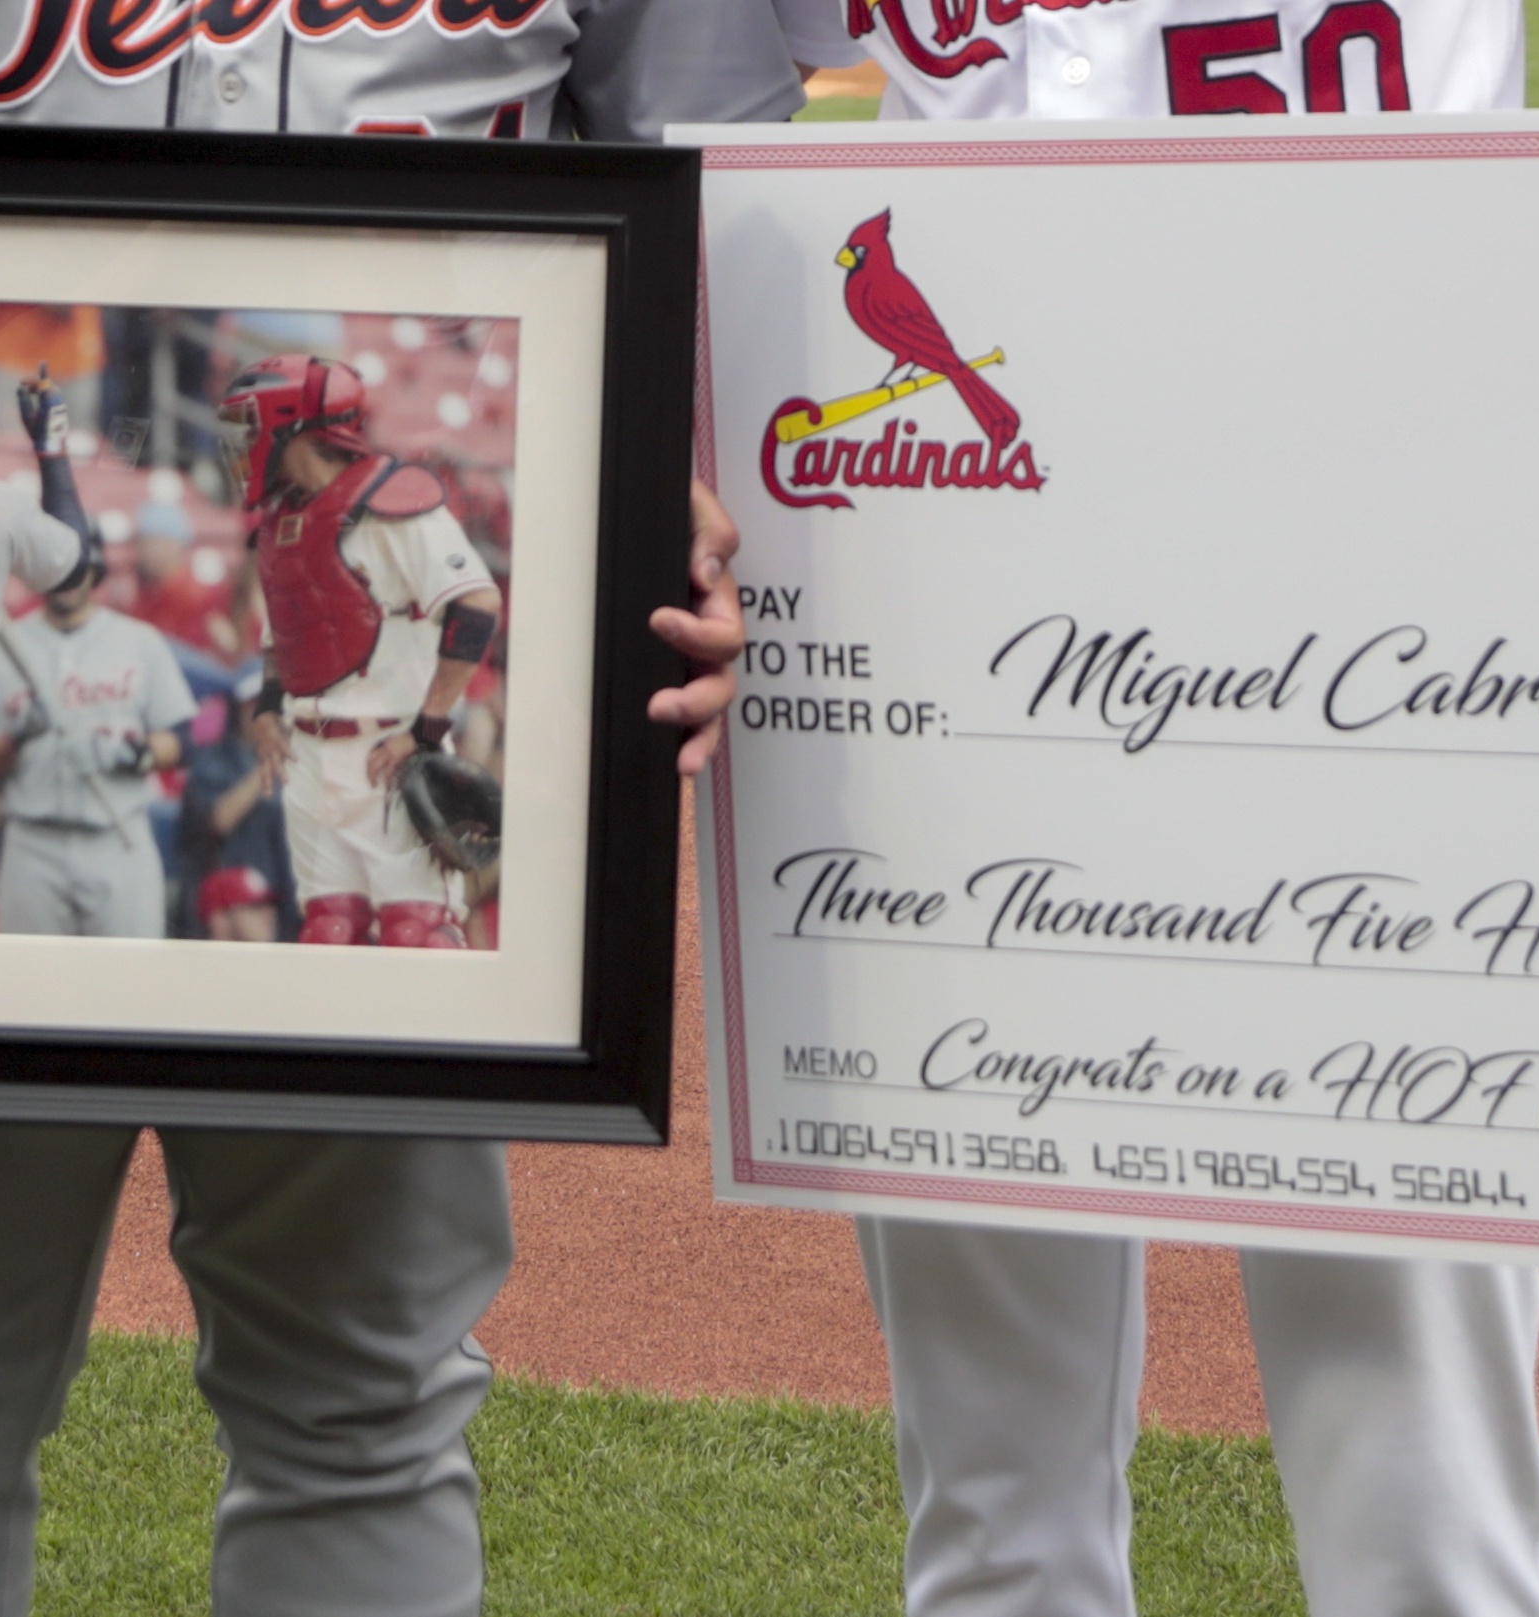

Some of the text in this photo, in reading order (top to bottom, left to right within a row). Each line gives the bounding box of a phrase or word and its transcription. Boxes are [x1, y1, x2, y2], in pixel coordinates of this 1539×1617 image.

[760, 396, 1048, 511] Cardinals
[738, 586, 801, 621] PAY
[741, 641, 871, 680] TO THE
[989, 614, 1318, 755] Miguel
[741, 699, 949, 738] ORDER OF:
[772, 847, 947, 939] Three
[965, 856, 1285, 948] Thousand
[1289, 871, 1436, 967] Five
[783, 1044, 879, 1080] MEMO
[918, 1016, 1169, 1118] Congrats
[1175, 1056, 1248, 1101] on
[1254, 1065, 1294, 1103] a
[1092, 1141, 1376, 1199] 46519854554
[1391, 1164, 1528, 1209] 56844
